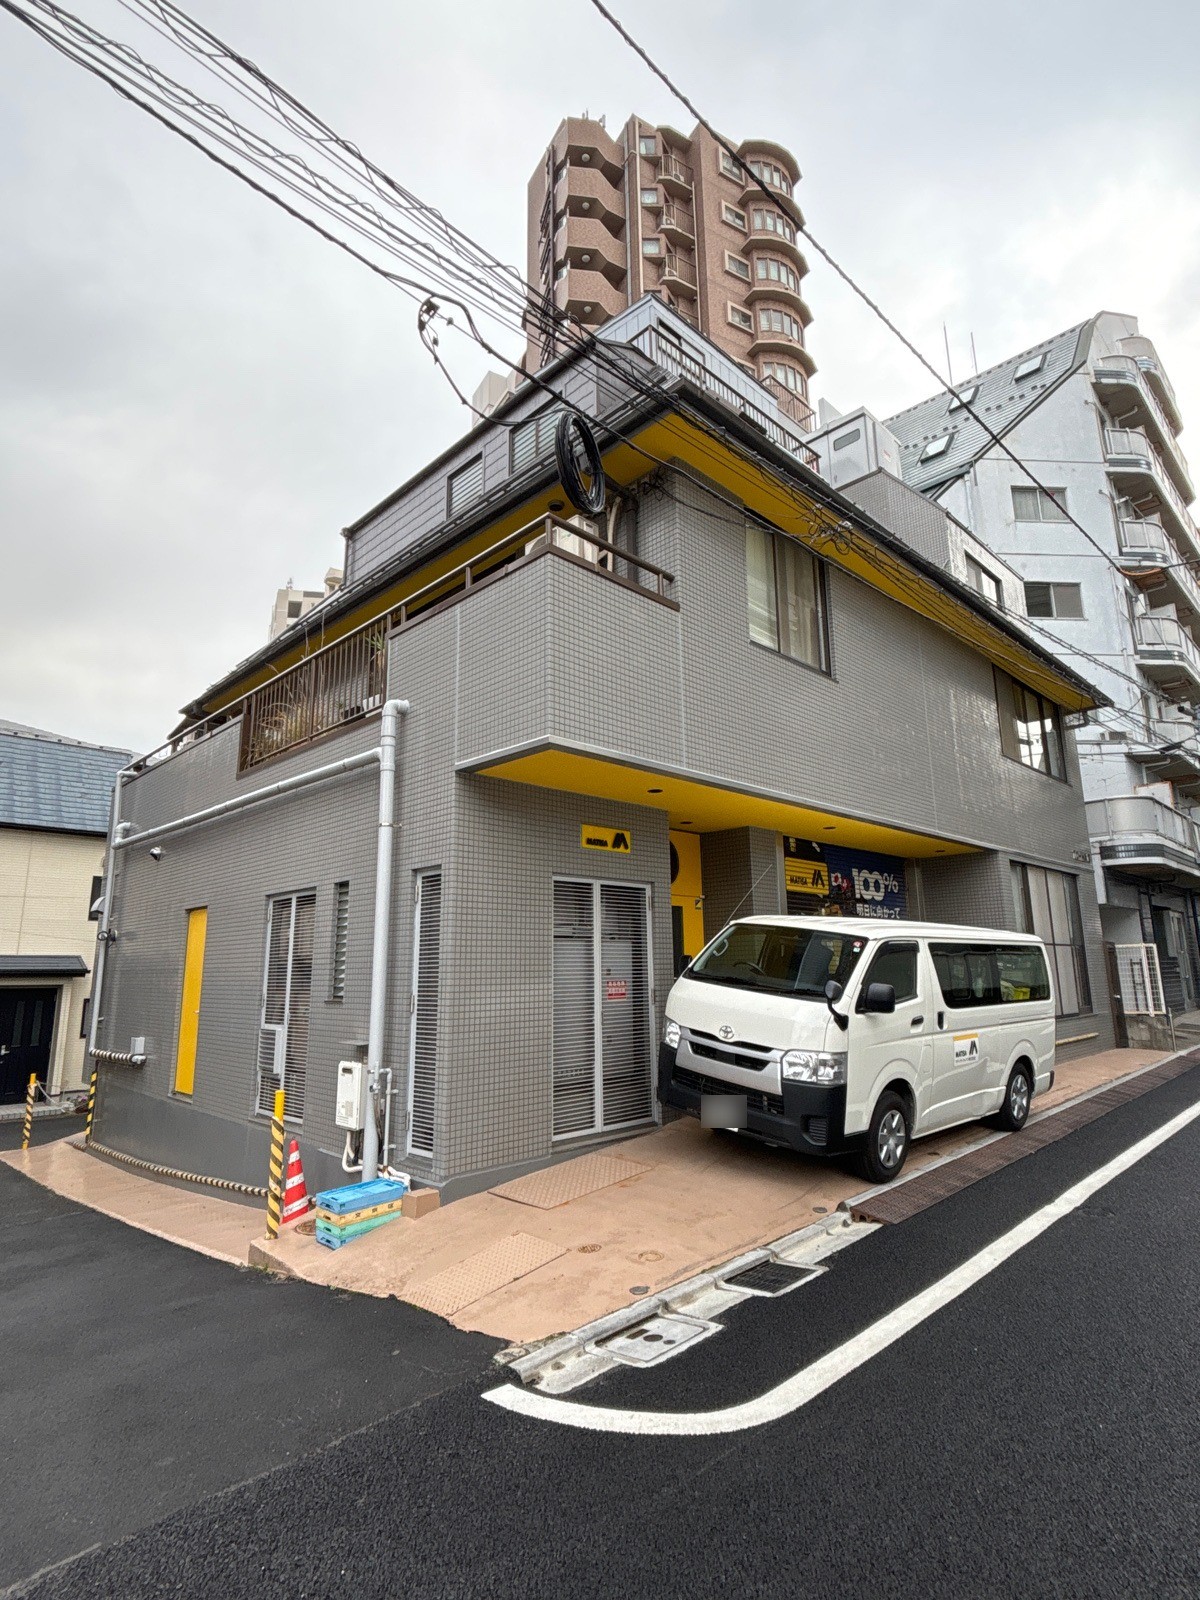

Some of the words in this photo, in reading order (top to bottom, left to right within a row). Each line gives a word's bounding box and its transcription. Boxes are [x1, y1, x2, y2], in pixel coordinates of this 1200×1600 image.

[852, 868, 899, 901] 100%
[856, 903, 901, 919] 明日に向かって
